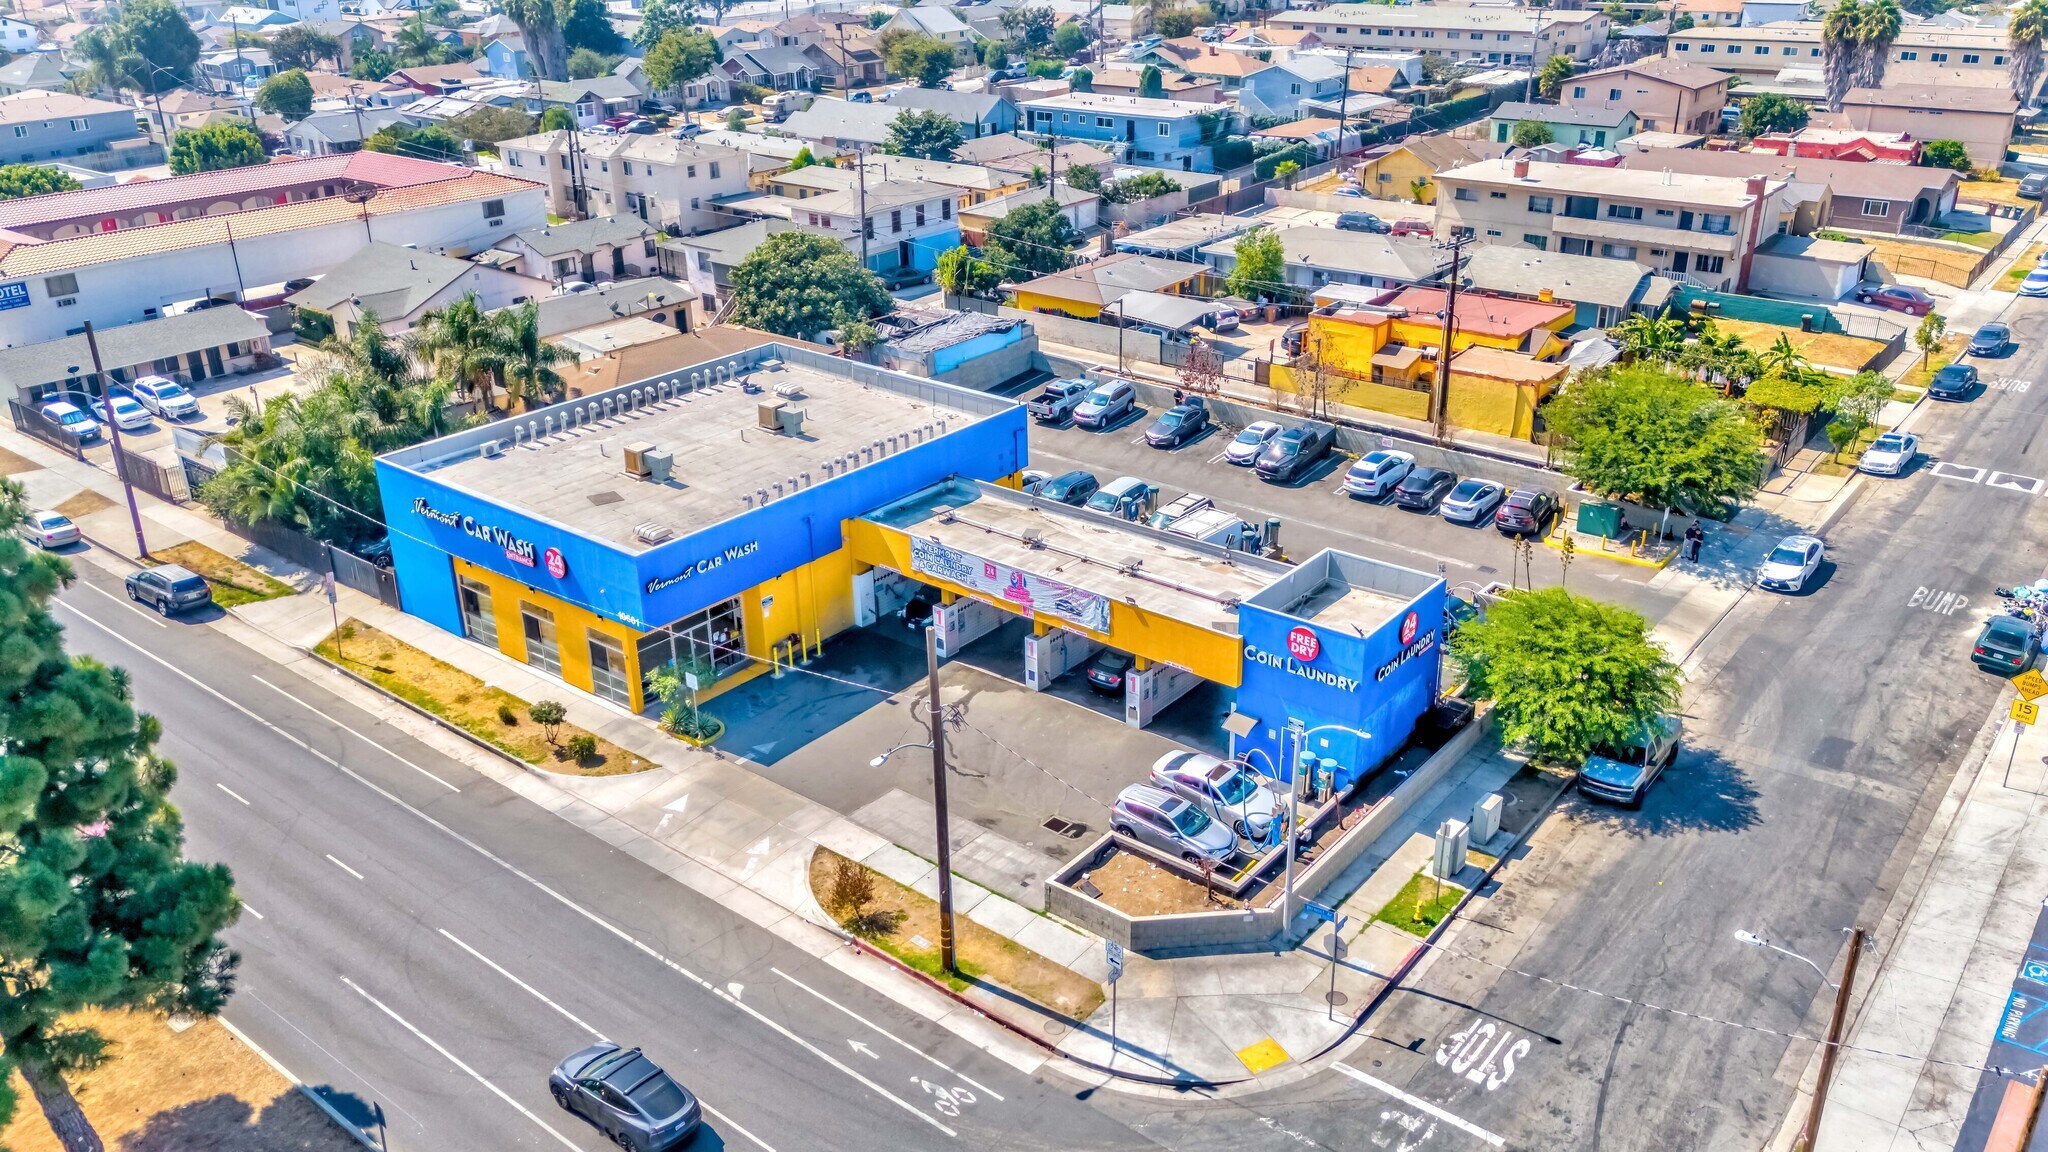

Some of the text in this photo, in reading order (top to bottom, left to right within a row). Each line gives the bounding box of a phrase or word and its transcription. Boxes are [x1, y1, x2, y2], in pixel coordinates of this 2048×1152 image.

[411, 497, 534, 559] Vermont CAR WASH
[546, 550, 562, 568] 24
[912, 548, 974, 575] COIN LAUNDRY
[921, 541, 962, 561] VERMONT
[647, 540, 759, 594] Vermont CAR WASH
[926, 562, 968, 583] CARWASH
[1907, 586, 1969, 616] BUMP
[1403, 613, 1417, 637] 24
[1290, 632, 1317, 648] FREE
[1291, 644, 1315, 658] DRY
[1377, 657, 1399, 682] COIN
[1400, 629, 1436, 665] LAUNDRY
[1244, 645, 1359, 693] COIN LAUNDRY
[2015, 713, 2031, 721] MPH
[2018, 703, 2033, 715] 15
[2001, 995, 2028, 1039] NO PARKING
[1436, 1018, 1531, 1091] STOP
